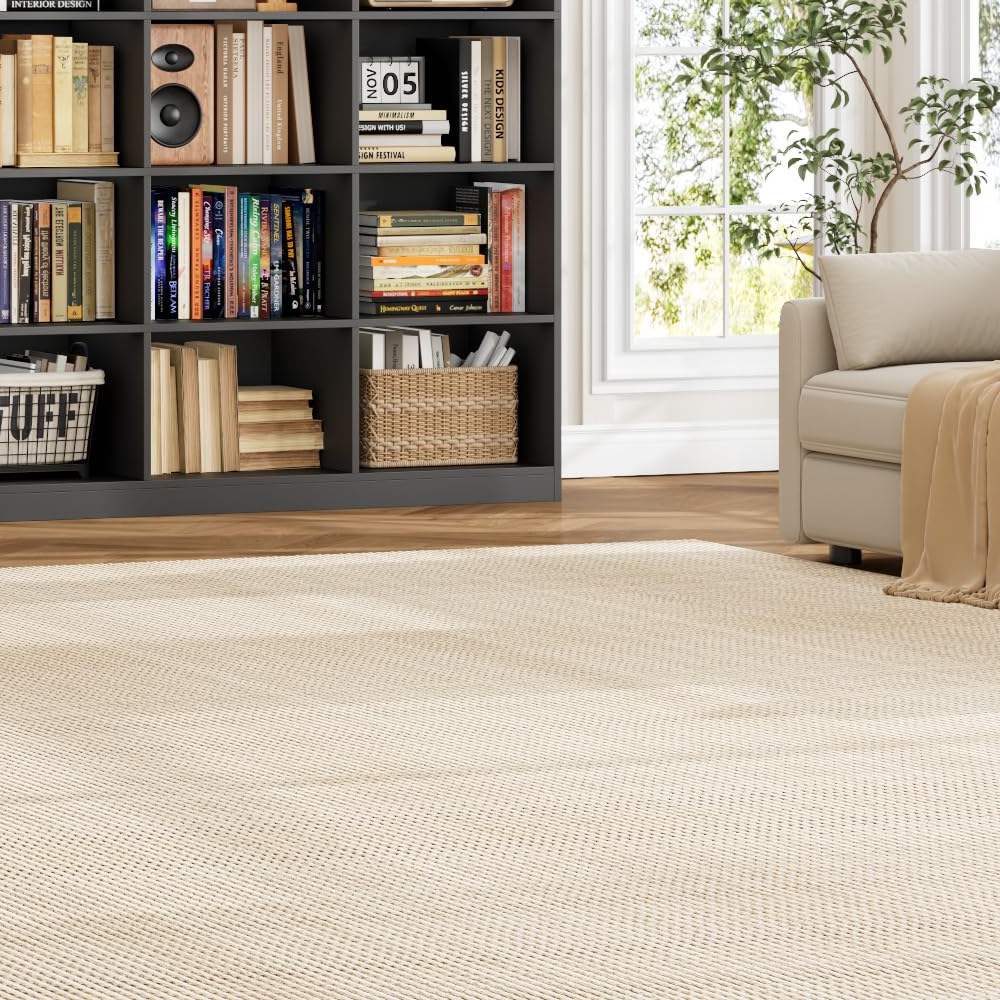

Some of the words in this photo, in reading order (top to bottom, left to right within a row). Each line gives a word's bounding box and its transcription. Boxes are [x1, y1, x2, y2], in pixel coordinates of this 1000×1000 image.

[275, 41, 284, 74] England
[367, 68, 377, 99] NOV
[382, 72, 417, 96] 05
[495, 70, 504, 95] KIDS
[495, 97, 504, 139] DESIGN
